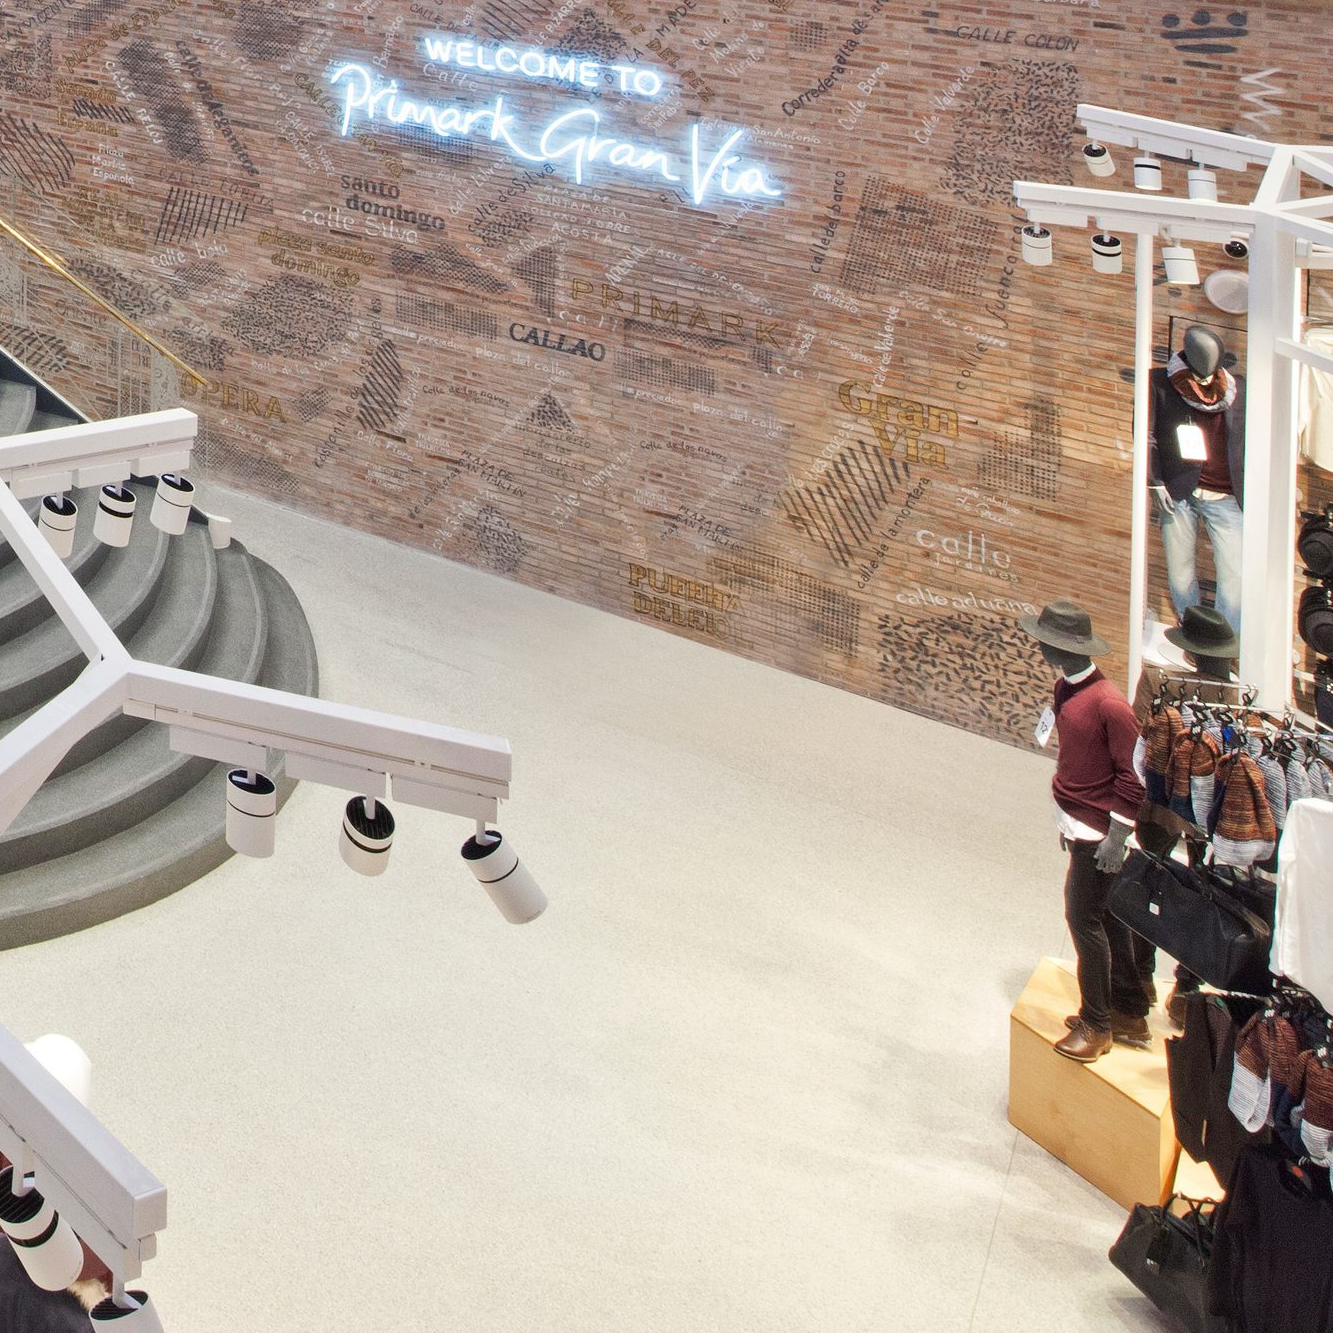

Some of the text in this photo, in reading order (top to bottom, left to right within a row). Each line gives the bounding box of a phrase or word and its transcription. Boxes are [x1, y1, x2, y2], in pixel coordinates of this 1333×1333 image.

[954, 24, 1082, 53] CALLE COLON
[424, 36, 661, 97] WELCOME TO
[857, 61, 890, 97] Barco
[330, 64, 546, 160] Primark
[539, 108, 680, 185] Gran
[341, 174, 401, 200] santo
[301, 205, 355, 231] calle
[344, 194, 446, 231] domingo
[269, 250, 361, 288] domingo
[571, 276, 781, 350] PRIMARK
[508, 322, 606, 363] CALLAO
[838, 378, 960, 439] Gran
[867, 417, 947, 468] Via
[460, 449, 516, 482] PLAZA DE
[893, 476, 931, 528] montera
